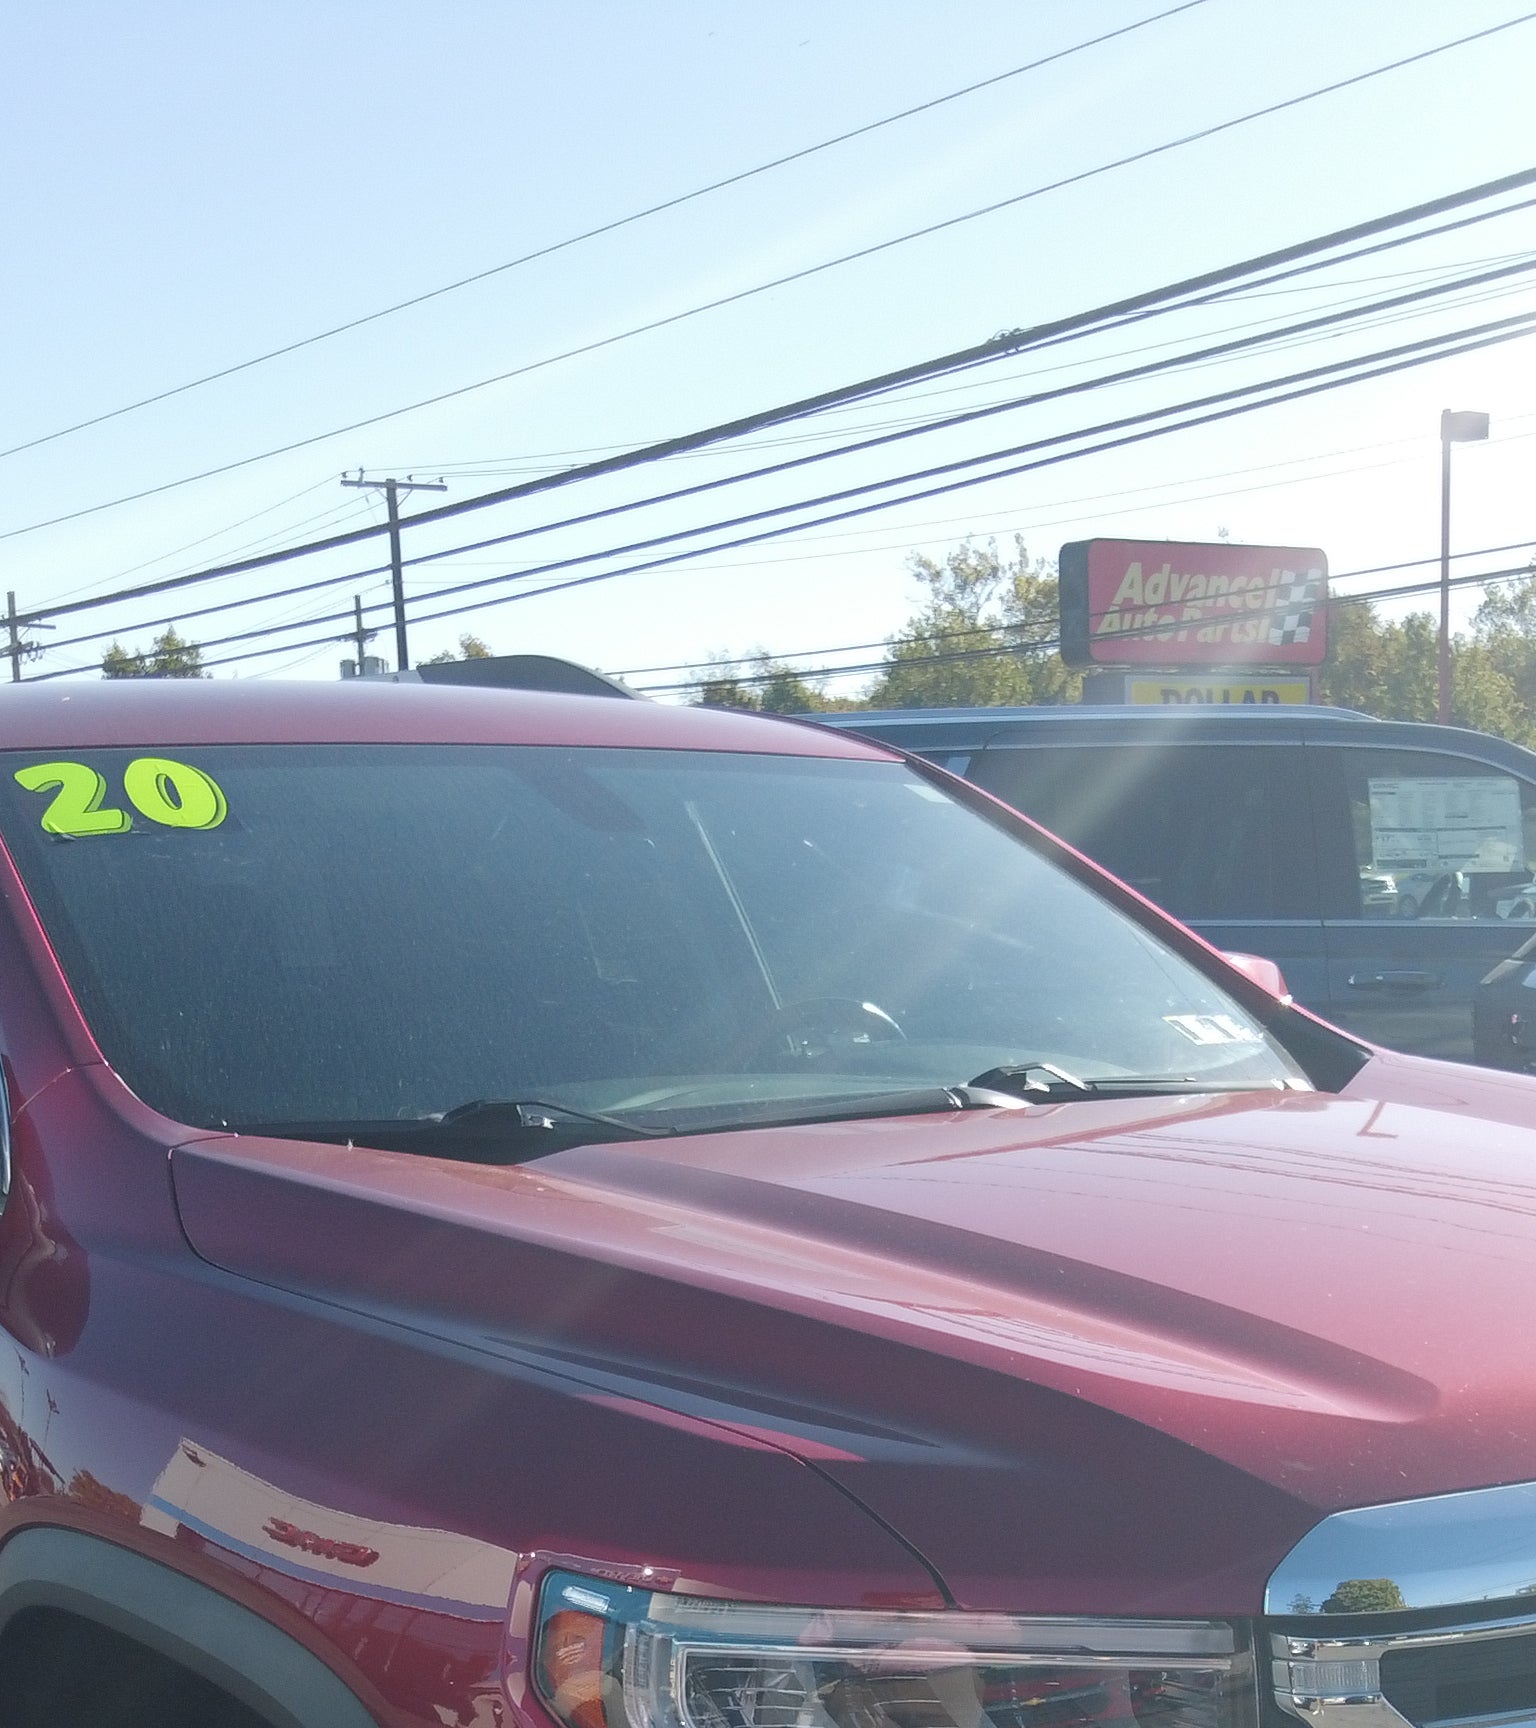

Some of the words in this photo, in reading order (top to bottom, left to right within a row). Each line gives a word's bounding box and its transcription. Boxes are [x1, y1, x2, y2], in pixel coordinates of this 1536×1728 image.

[1112, 562, 1269, 610] Advance
[1096, 606, 1175, 642] Auto
[1177, 607, 1264, 643] Parts
[14, 757, 228, 838] 20
